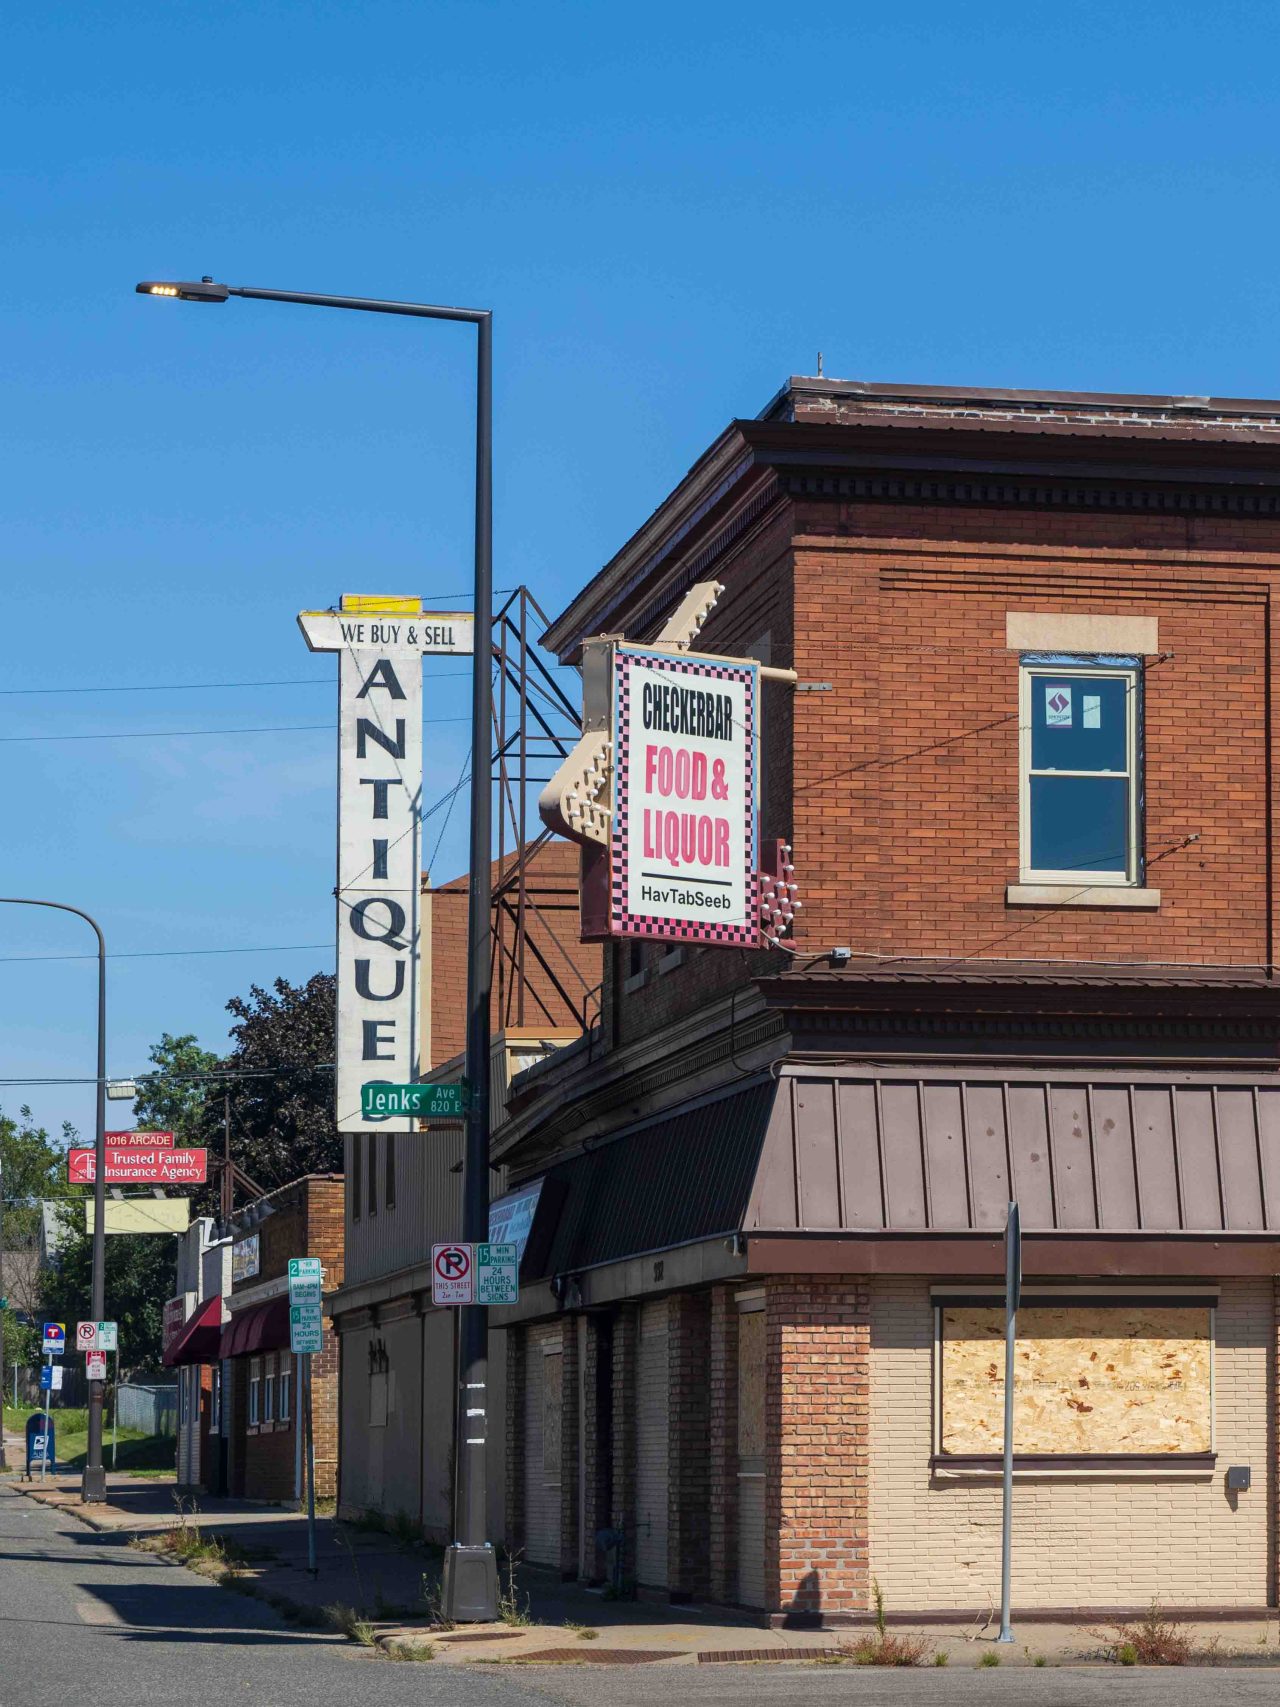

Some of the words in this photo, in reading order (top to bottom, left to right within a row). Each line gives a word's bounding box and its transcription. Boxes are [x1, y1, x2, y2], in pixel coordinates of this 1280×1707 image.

[341, 624, 364, 643] WE
[371, 624, 401, 644] BUY
[407, 625, 418, 645] &
[425, 626, 456, 646] SELL
[642, 681, 733, 742] CHECKERBAR
[645, 744, 708, 801] FOOD
[711, 758, 729, 801] &
[643, 808, 730, 868] LIQUOR
[641, 885, 732, 910] HavTabSeeb
[365, 1088, 421, 1110] Jenks
[436, 1087, 455, 1099] Ave
[430, 1101, 449, 1112] 820
[106, 1136, 127, 1145] 1016
[129, 1136, 171, 1145] ARCADE
[112, 1152, 155, 1165] Trusted
[158, 1152, 196, 1167] Family
[104, 1165, 157, 1177] Insurance
[161, 1165, 203, 1179] Agency
[479, 1248, 489, 1263] 15
[496, 1247, 509, 1255] MIN
[491, 1256, 515, 1264] PARKING
[291, 1263, 298, 1275] 2
[492, 1267, 502, 1275] 24
[436, 1282, 449, 1290] THIS
[450, 1281, 471, 1290] STREET
[484, 1276, 511, 1285] HOURS
[481, 1284, 515, 1293] BETWEEN
[487, 1293, 509, 1301] SIGNS
[294, 1329, 319, 1337] HOURS
